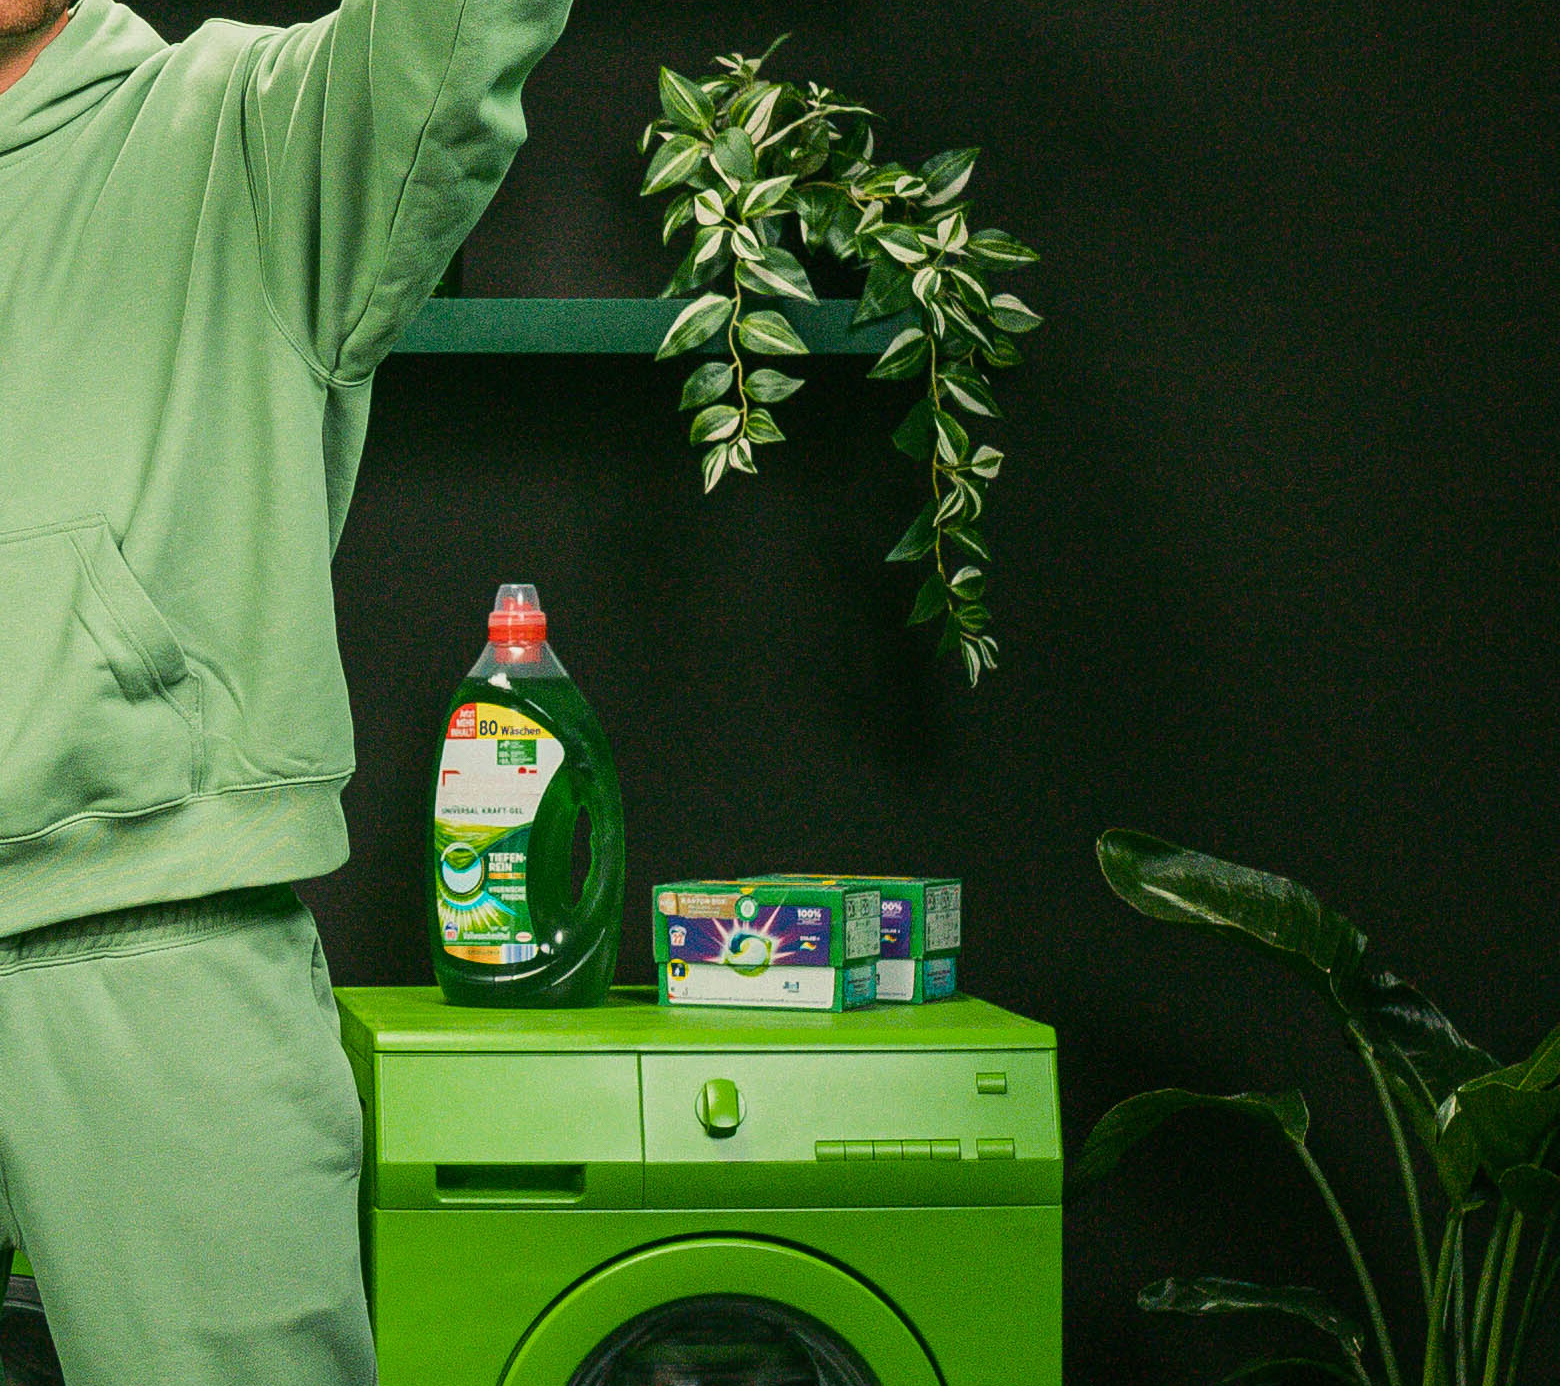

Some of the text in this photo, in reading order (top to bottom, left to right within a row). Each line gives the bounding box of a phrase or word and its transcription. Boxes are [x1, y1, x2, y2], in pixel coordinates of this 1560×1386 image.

[479, 720, 542, 735] 80 Wäschen
[488, 853, 527, 863] TIEFEN-
[488, 862, 513, 872] REIN
[881, 901, 903, 911] 00%
[797, 909, 822, 918] 100%
